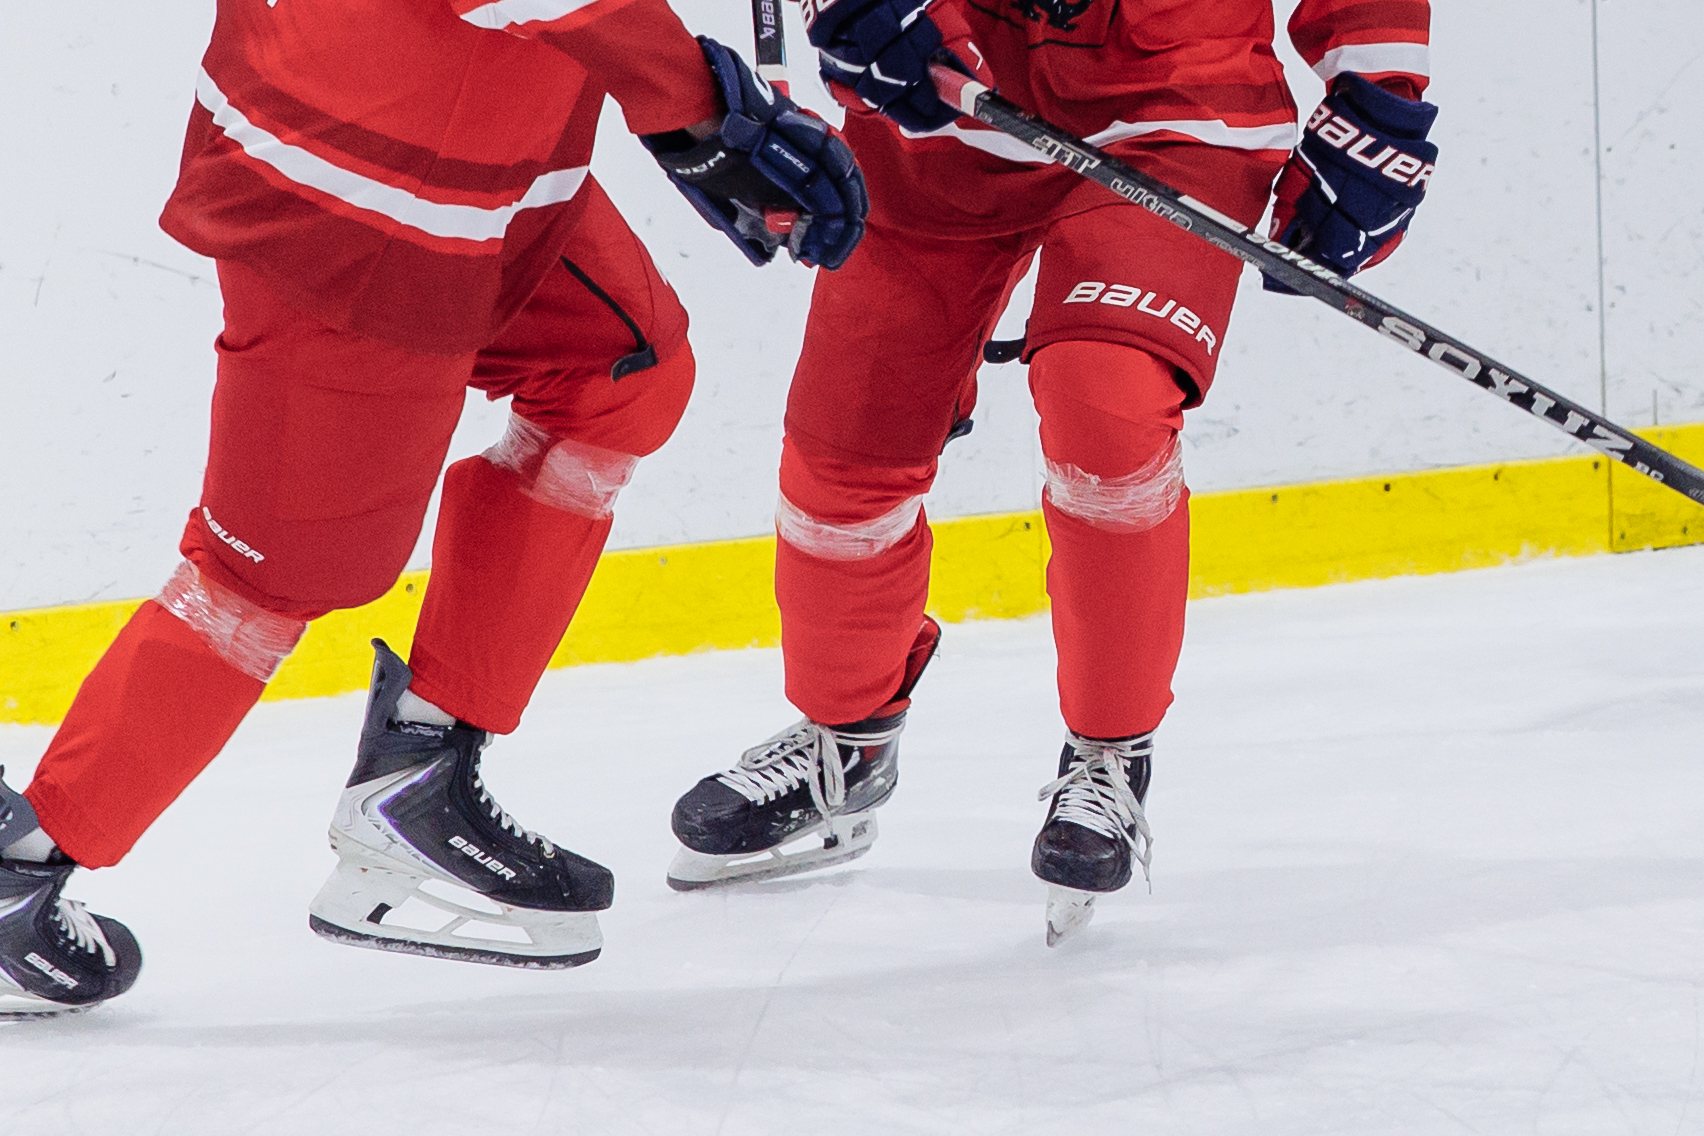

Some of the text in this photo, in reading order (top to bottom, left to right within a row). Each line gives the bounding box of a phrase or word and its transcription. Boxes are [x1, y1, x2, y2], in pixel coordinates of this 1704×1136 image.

[1306, 103, 1436, 192] BAUER
[1063, 281, 1217, 356] BAUER
[1377, 315, 1635, 462] SOYUZ
[202, 506, 265, 564] BAUER
[448, 835, 517, 881] BAUER
[24, 951, 79, 990] BAUER
